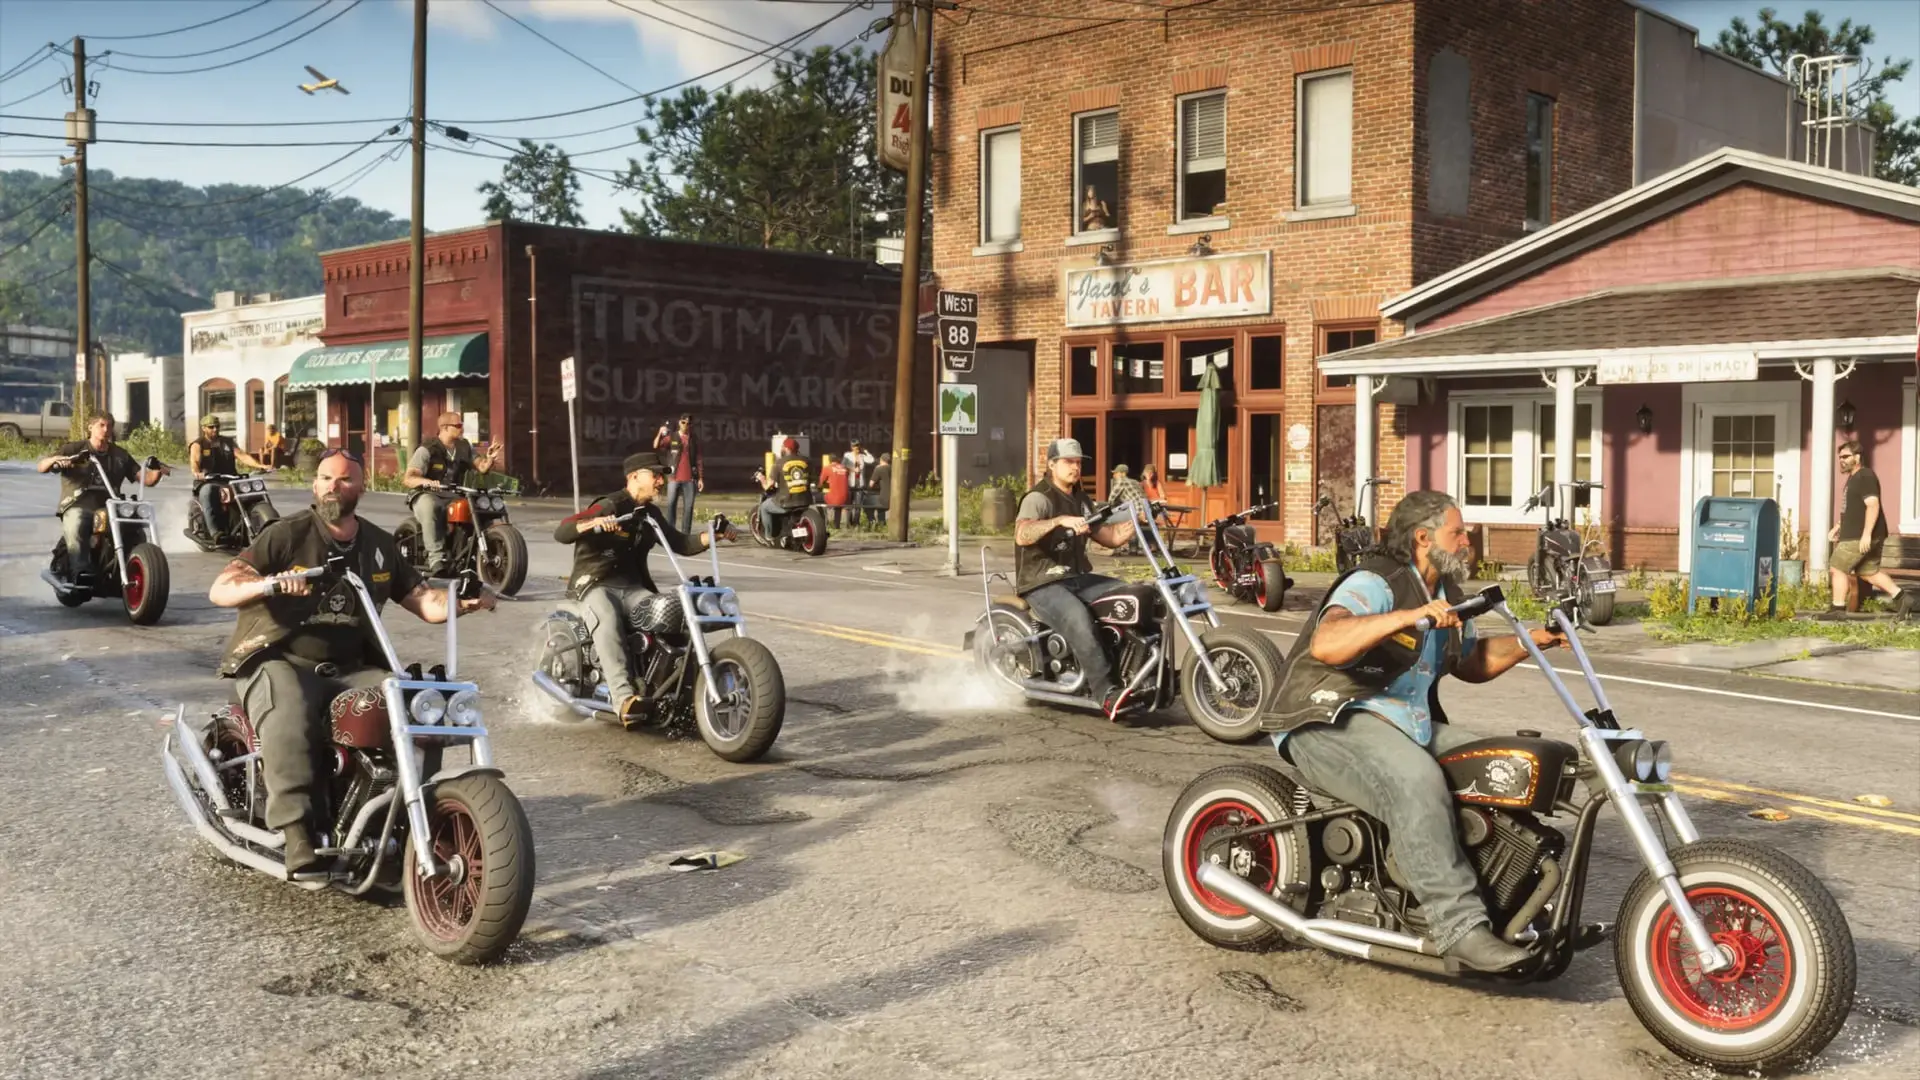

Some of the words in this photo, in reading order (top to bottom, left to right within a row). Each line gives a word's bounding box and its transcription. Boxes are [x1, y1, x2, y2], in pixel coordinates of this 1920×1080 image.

[1172, 260, 1256, 308] BAR
[944, 294, 974, 313] WEST
[1089, 297, 1160, 319] TAVERN
[583, 292, 894, 359] TROTMAN'S
[948, 325, 970, 346] 88
[1677, 359, 1749, 373] PHMACY
[584, 363, 729, 406] SUPER
[740, 373, 894, 412] MARKET
[583, 416, 645, 441] MEAT
